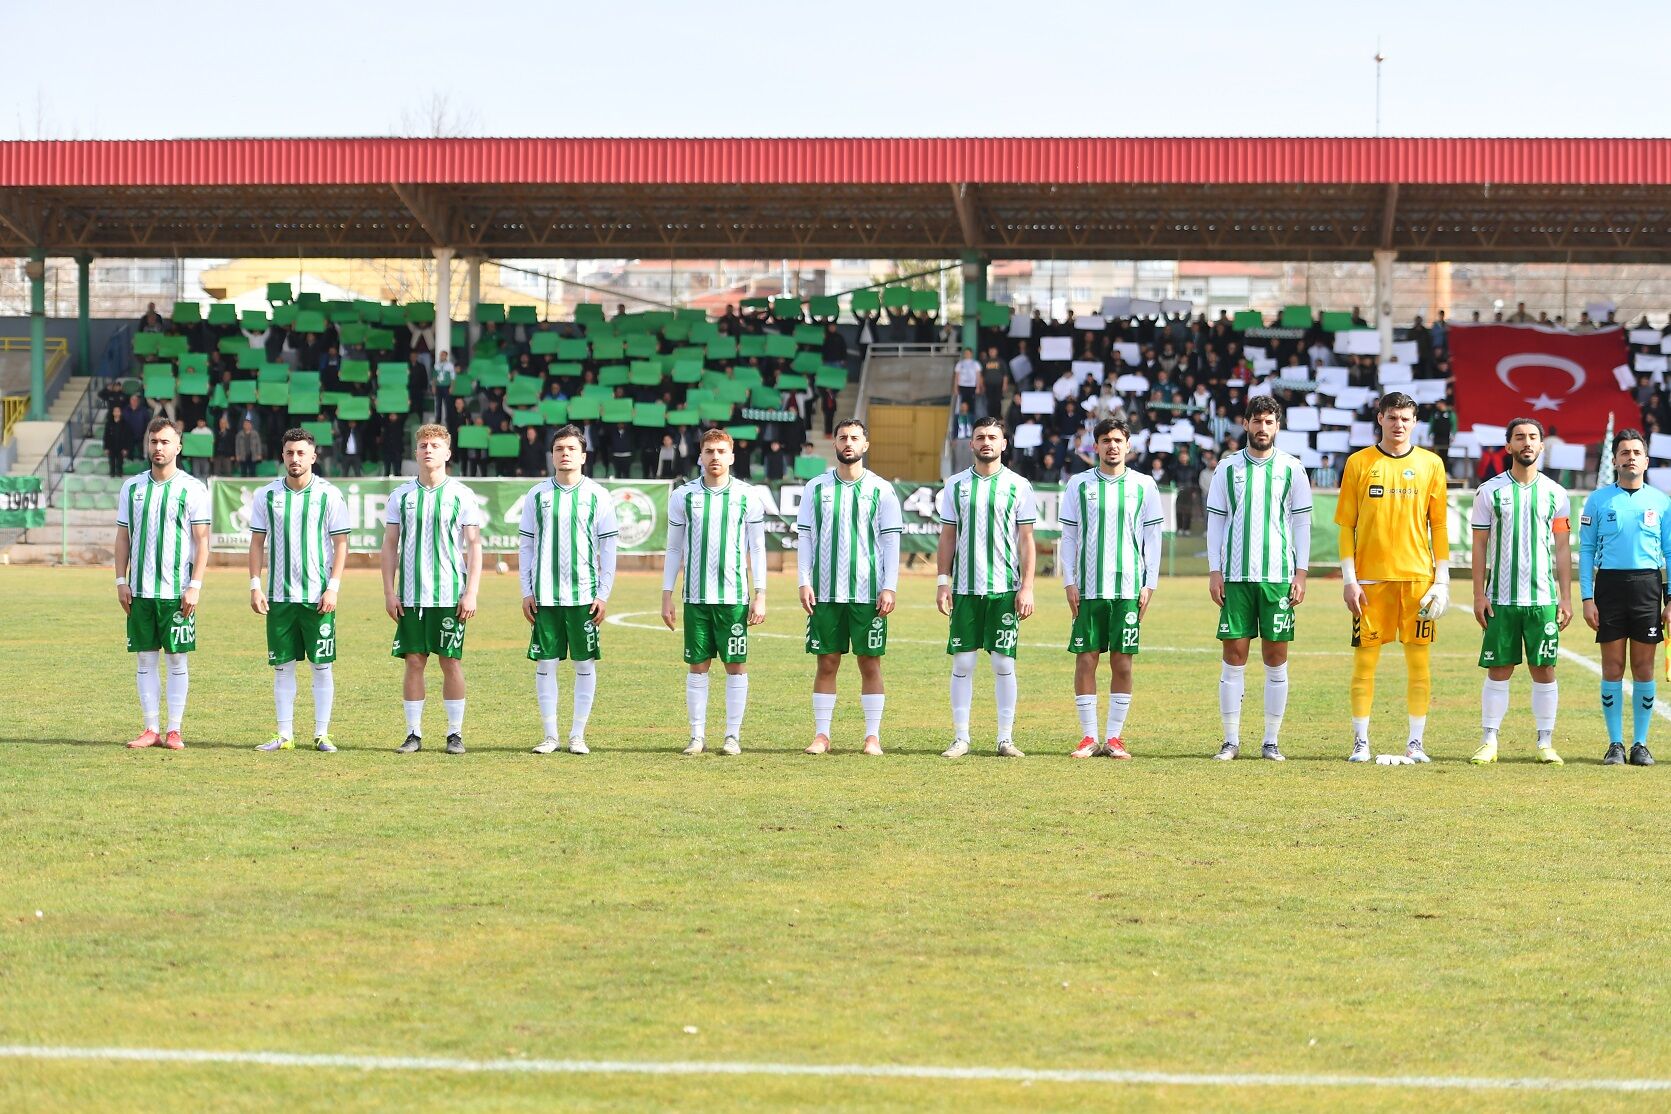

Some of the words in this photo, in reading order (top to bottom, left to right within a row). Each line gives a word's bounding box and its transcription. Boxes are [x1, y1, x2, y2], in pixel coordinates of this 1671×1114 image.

[1273, 613, 1290, 633] 54
[1415, 619, 1430, 638] 16
[170, 625, 190, 645] 70
[440, 629, 456, 650] 17
[995, 629, 1014, 649] 28
[1122, 627, 1138, 647] 32
[315, 638, 334, 658] 20
[727, 636, 747, 656] 88
[1538, 638, 1558, 659] 45
